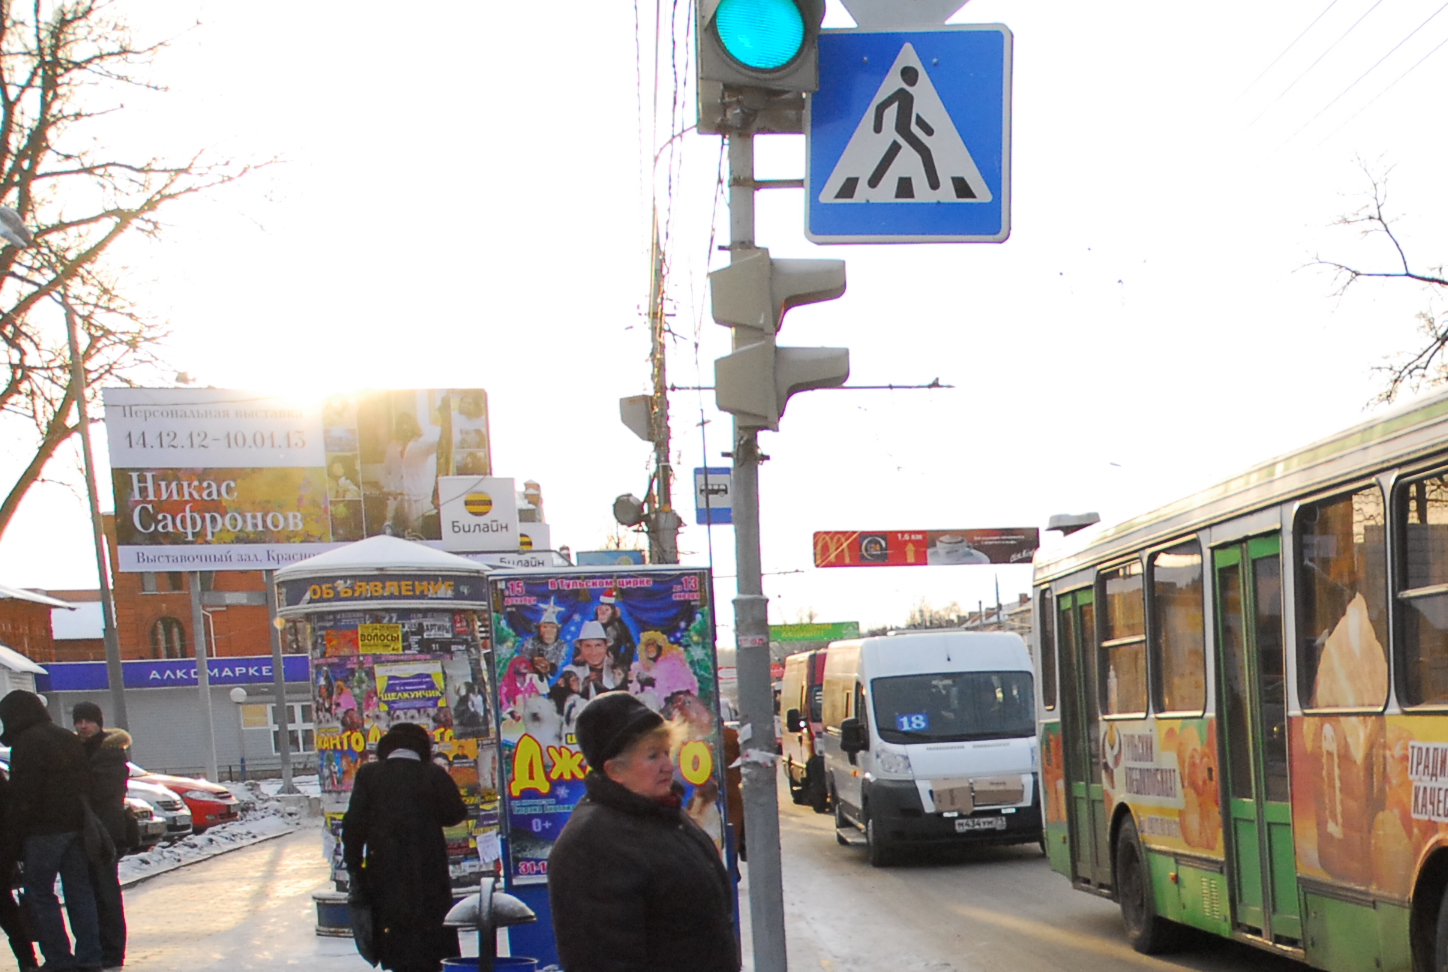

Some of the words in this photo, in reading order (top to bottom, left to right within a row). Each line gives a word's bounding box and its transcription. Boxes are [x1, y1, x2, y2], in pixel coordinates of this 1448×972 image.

[122, 405, 230, 421] Персональная
[235, 408, 303, 419] выставка
[128, 471, 238, 501] Никас
[132, 503, 304, 541] Сафронов
[451, 520, 509, 534] Билайн
[136, 549, 233, 565] Выставочный
[266, 549, 322, 565] Красно
[508, 581, 526, 596] 15
[682, 576, 700, 591] 13
[549, 579, 557, 590] В
[559, 578, 614, 590] Тульском
[617, 577, 653, 589] цирке
[360, 633, 400, 643] ВОЛОСЫ
[150, 665, 285, 680] АЛКОМАРКЕ
[380, 689, 442, 701] ЩЕЛКУНЧИК
[899, 714, 926, 730] 18
[531, 818, 552, 832] 0+
